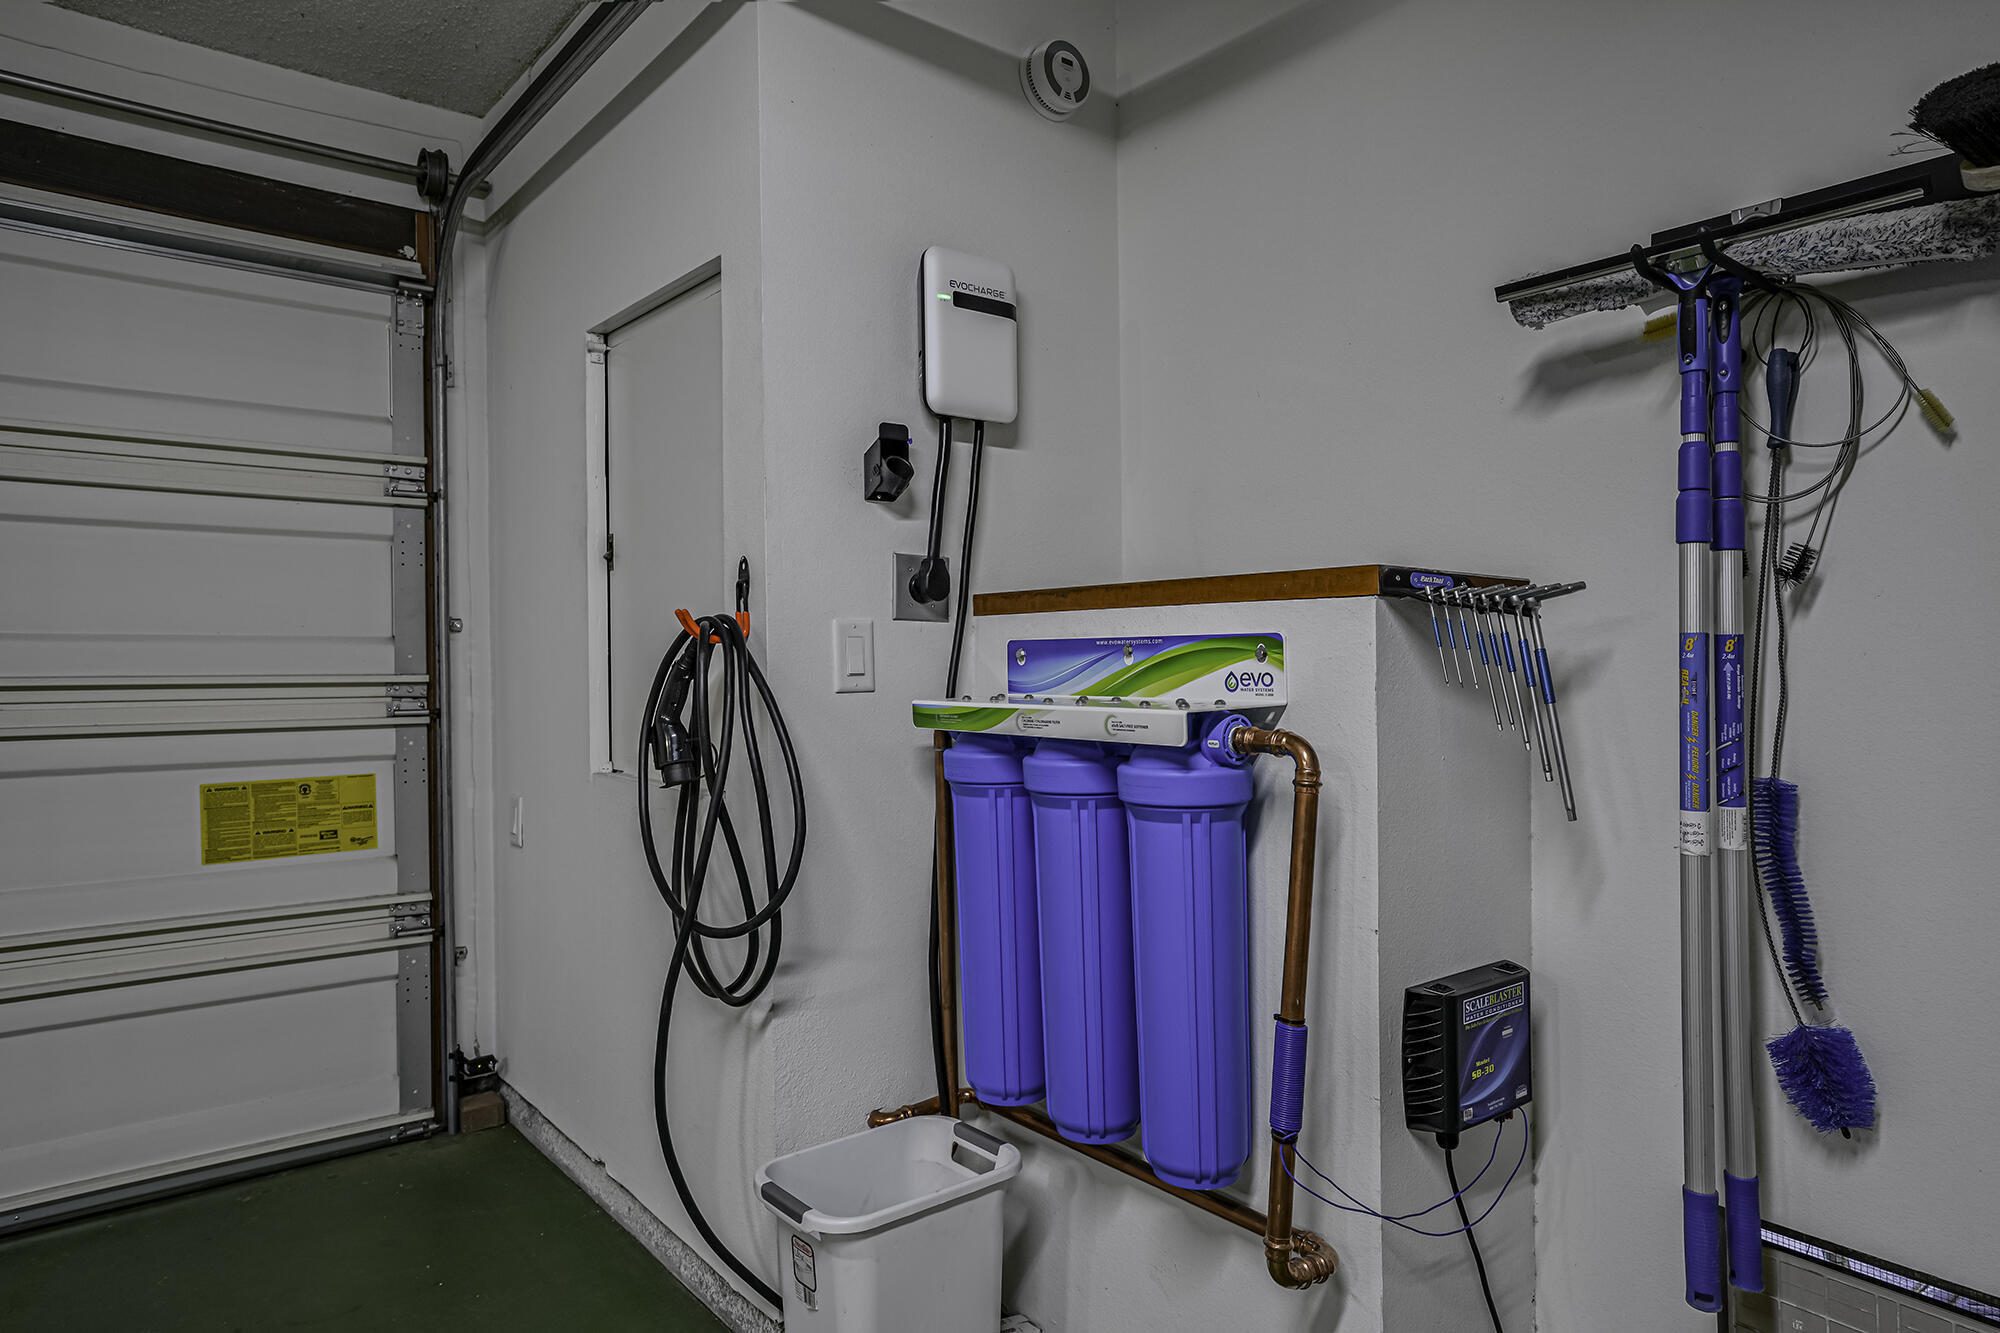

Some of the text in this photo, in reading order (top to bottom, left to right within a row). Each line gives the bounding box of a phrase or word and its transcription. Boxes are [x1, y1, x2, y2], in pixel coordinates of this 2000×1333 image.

[949, 279, 1005, 299] EVOCHARGE
[1239, 671, 1274, 687] evo
[1691, 710, 1700, 810] DANGER PELIGRO DANGER
[1465, 985, 1522, 1014] SCALEBLASTER
[1465, 1011, 1483, 1021] WATER
[1484, 998, 1522, 1015] CONDITIONER
[1471, 1063, 1495, 1080] SB-30
